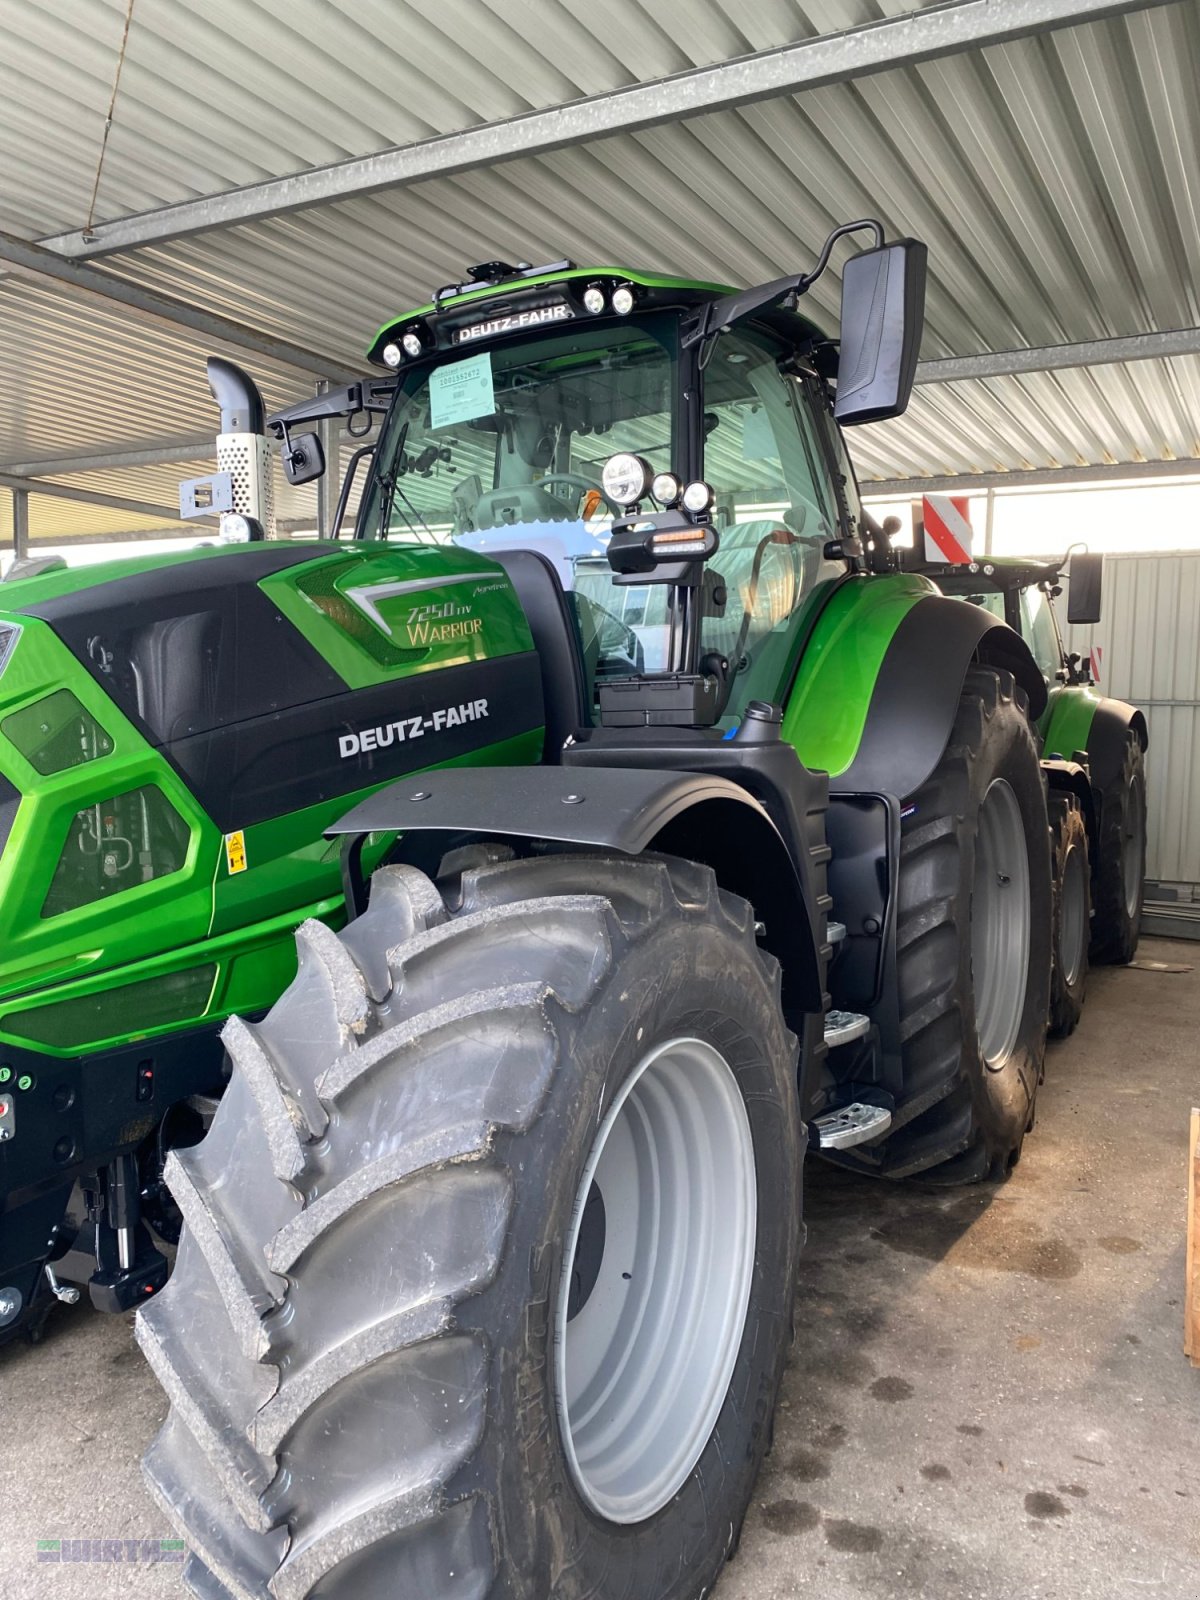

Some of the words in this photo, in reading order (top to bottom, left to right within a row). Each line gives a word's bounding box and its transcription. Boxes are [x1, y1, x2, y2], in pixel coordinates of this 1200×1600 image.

[459, 305, 566, 341] DEUTZ-FAHR
[472, 583, 508, 598] Agrotron
[407, 602, 455, 624] 7250
[407, 619, 482, 646] WARRIOR
[338, 699, 489, 758] DEUTZ-FAHR
